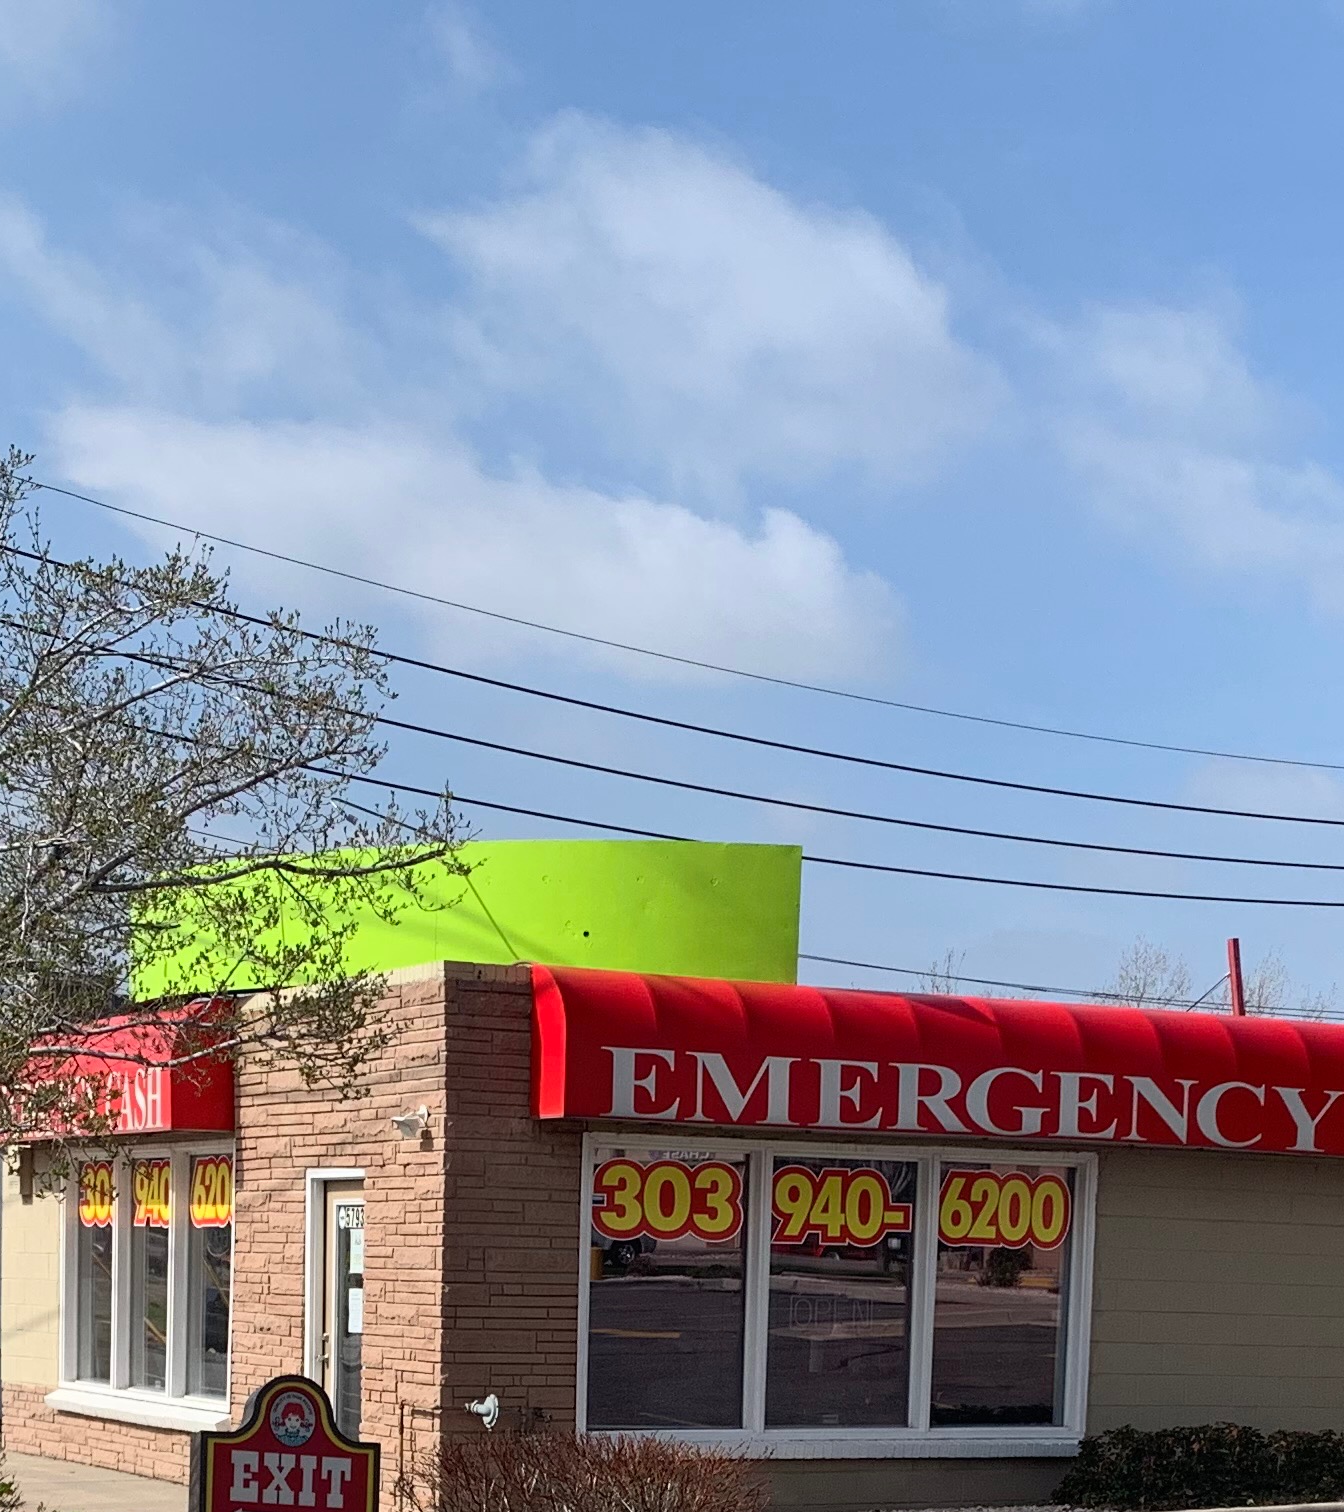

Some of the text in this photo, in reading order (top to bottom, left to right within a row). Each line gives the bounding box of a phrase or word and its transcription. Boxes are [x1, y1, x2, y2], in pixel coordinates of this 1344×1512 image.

[81, 1163, 113, 1226] 30
[191, 1157, 235, 1228] 620
[594, 1160, 1070, 1249] 303 940- 6200
[795, 1299, 870, 1326] OPEN
[230, 1450, 351, 1508] EXIT
